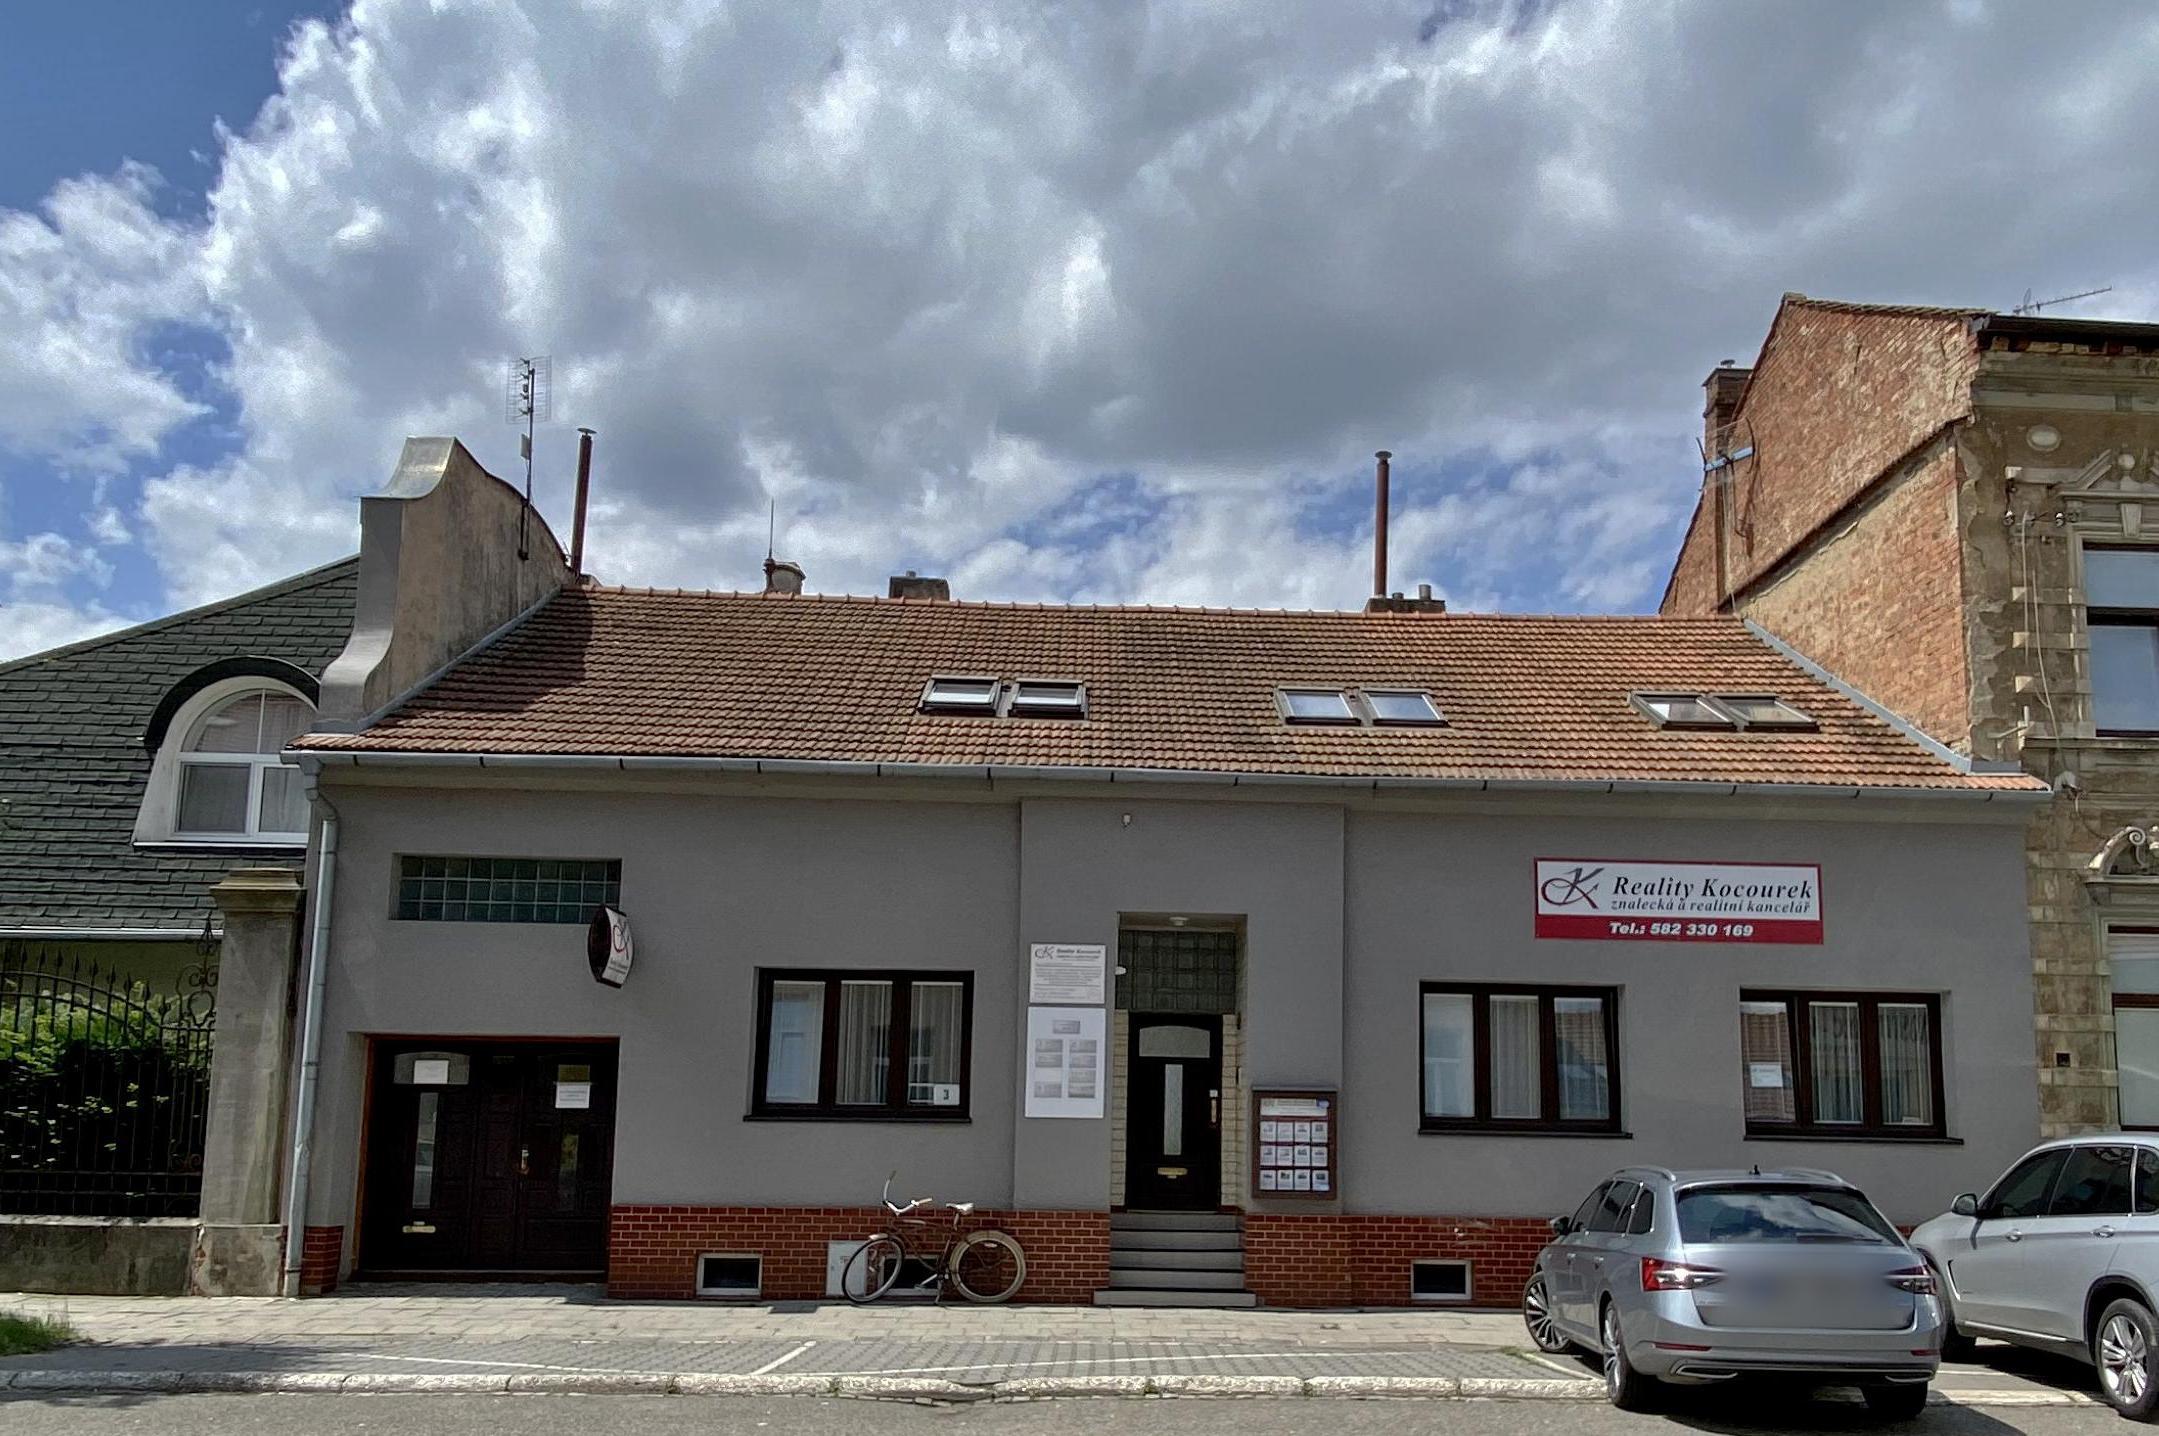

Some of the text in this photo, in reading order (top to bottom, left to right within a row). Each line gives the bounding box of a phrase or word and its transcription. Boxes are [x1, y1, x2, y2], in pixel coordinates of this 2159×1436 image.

[1612, 876, 1812, 899] Reality Kocourek
[1609, 922, 1754, 937] Tel.: 582 330 169
